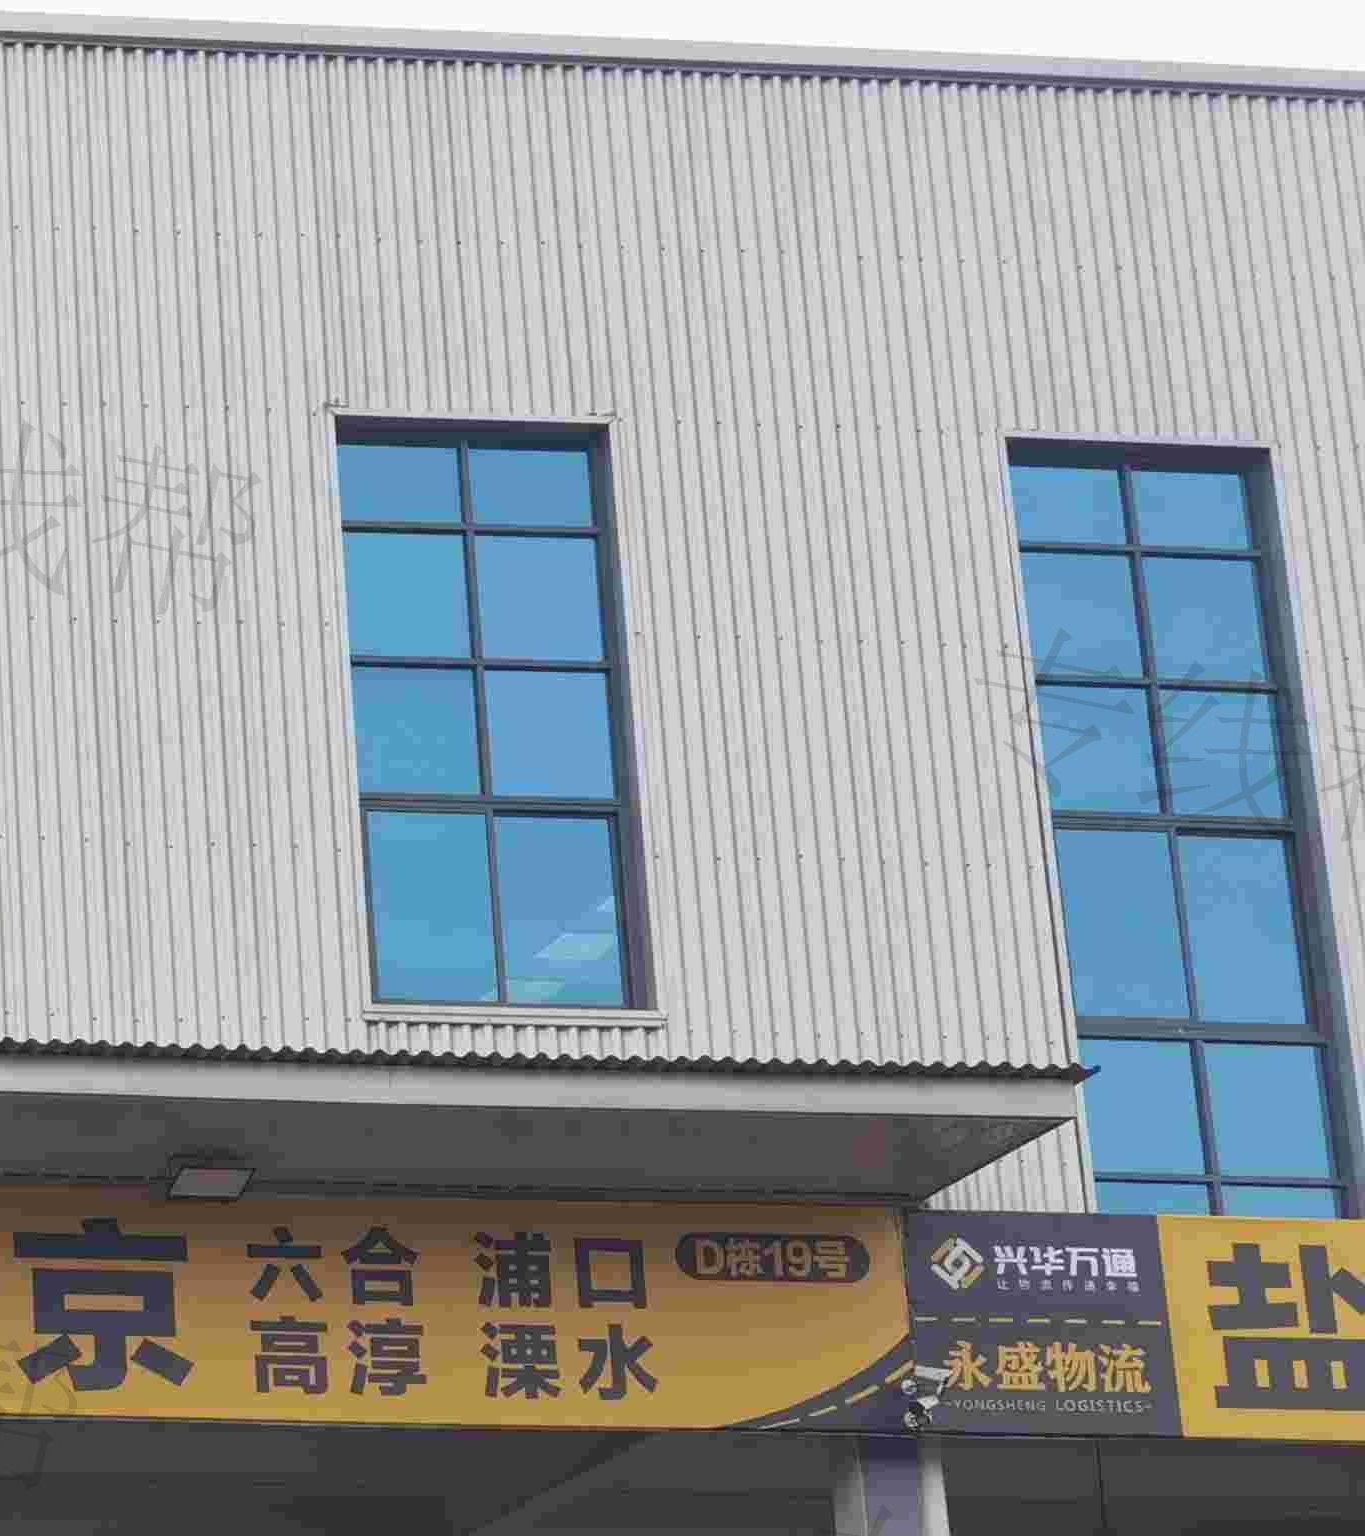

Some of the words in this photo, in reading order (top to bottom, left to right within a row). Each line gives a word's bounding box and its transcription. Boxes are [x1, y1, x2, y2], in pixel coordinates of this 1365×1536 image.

[245, 1226, 422, 1307] 六合
[473, 1231, 648, 1309] 浦口
[693, 1237, 851, 1280] D栋19号
[992, 1245, 1139, 1278] 兴华万通
[1205, 1242, 1365, 1412] 盐
[248, 1315, 428, 1396] 高淳
[479, 1320, 659, 1401] 溧水
[943, 1340, 1152, 1394] 永盛物流
[953, 1399, 1046, 1412] YONGSHENG
[1054, 1399, 1143, 1415] LOGISTICS
